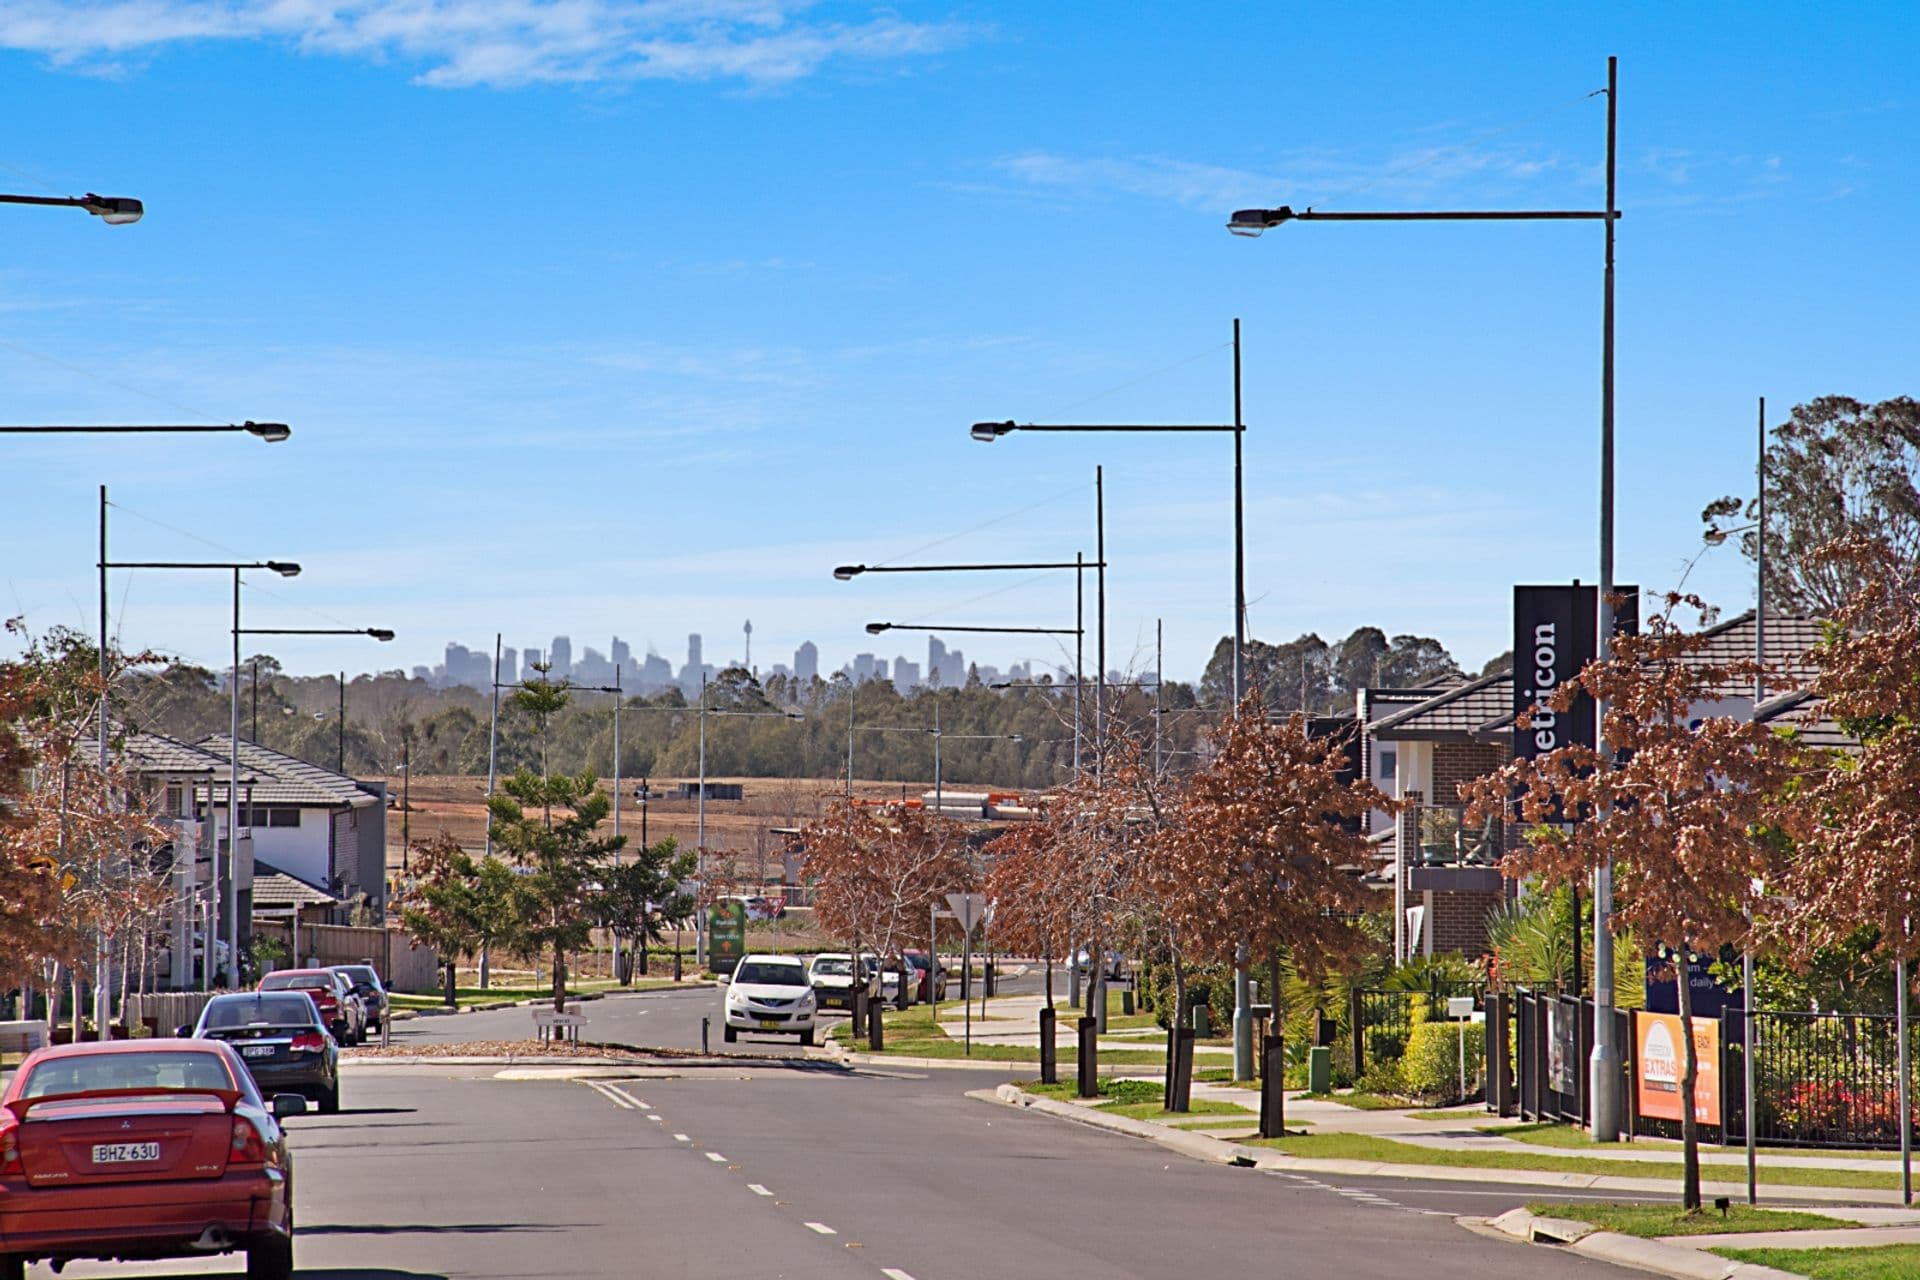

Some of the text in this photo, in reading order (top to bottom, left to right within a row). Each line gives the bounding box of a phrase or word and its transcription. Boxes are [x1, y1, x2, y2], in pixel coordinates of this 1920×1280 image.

[1524, 622, 1556, 768] etricon
[1690, 977, 1714, 989] daily
[1645, 1058, 1677, 1077] EXTRAS
